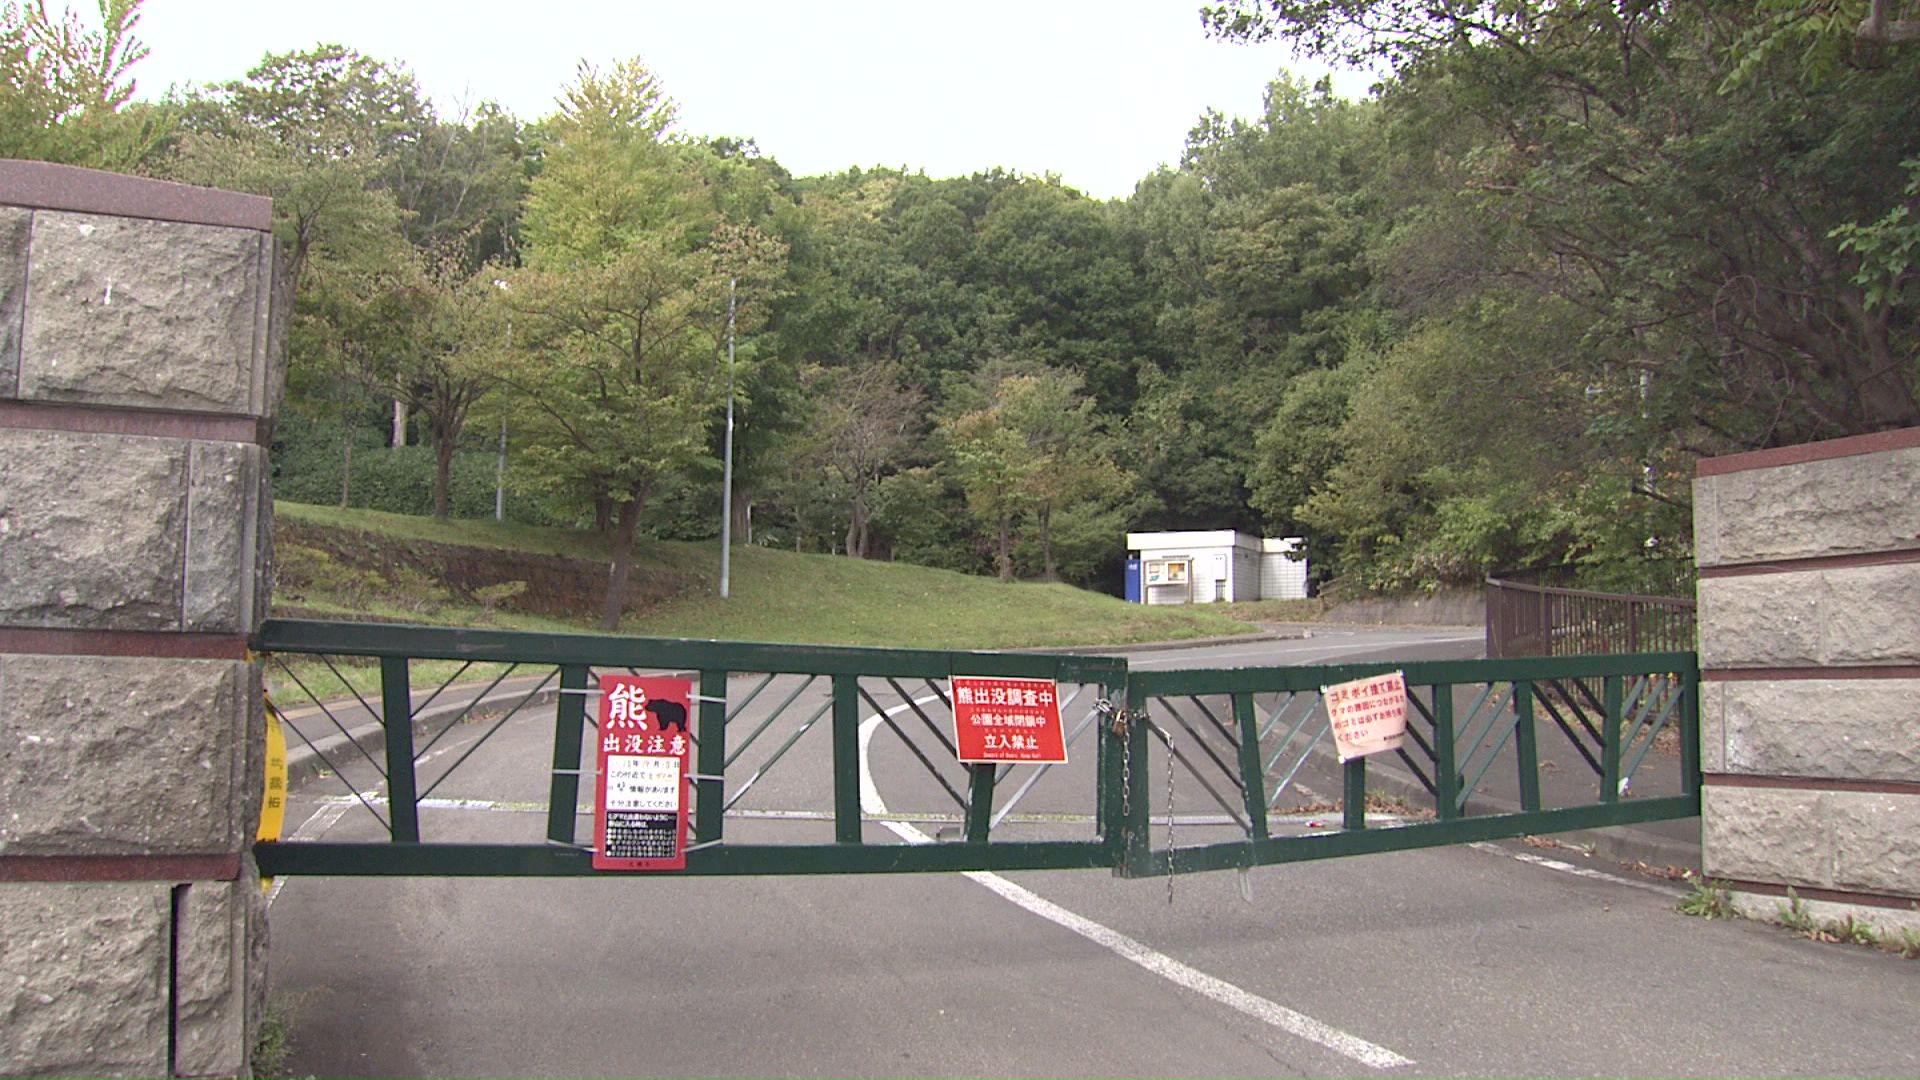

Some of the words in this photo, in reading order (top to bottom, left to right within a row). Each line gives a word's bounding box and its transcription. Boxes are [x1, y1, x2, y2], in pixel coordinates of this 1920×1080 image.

[957, 687, 1053, 707] 熊出没調査中
[607, 683, 648, 731] 熊
[971, 714, 1046, 727] 公園全域閉鎖中
[603, 733, 686, 756] 出没注意
[985, 734, 1039, 750] 立入禁止
[1338, 729, 1369, 742] ください
